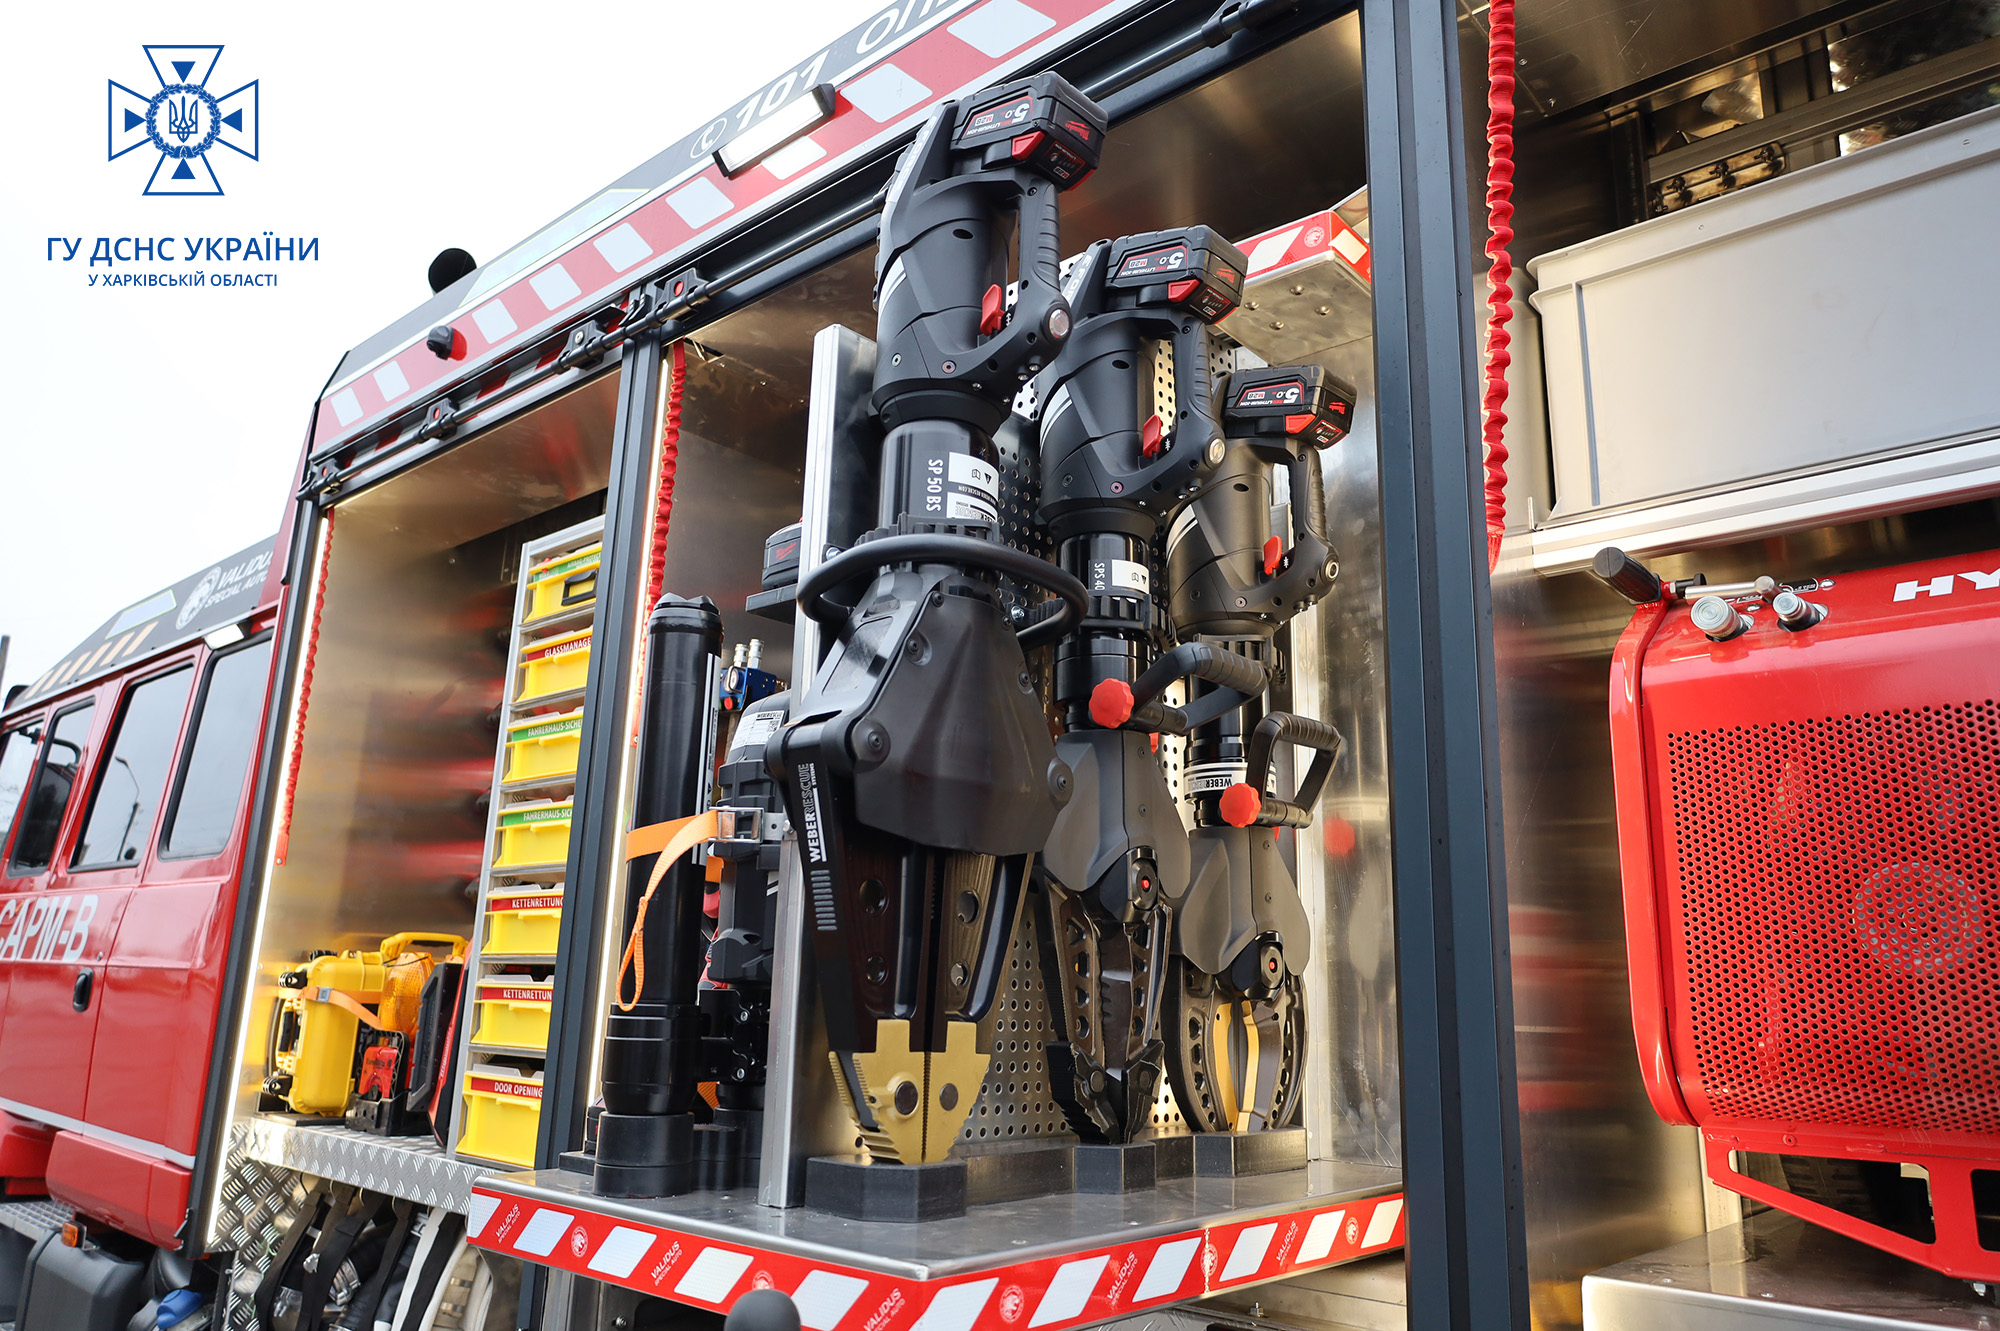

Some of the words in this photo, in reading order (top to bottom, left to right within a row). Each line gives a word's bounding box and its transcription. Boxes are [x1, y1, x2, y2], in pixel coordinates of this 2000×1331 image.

[975, 114, 994, 126] M28
[927, 458, 944, 475] SP
[926, 477, 943, 493] 50
[925, 495, 942, 512] BS
[217, 550, 273, 591] VALIDU
[1094, 562, 1106, 579] SPS
[1094, 580, 1106, 591] 40
[544, 637, 592, 658] GLASSMANAGE
[494, 1081, 512, 1094] DOOR
[513, 1084, 543, 1099] OPENING
[495, 1203, 519, 1237] VALIDUS
[1276, 1220, 1297, 1260] VALIDUS
[651, 1240, 680, 1279] VALIDUS
[1107, 1251, 1135, 1300] VALIDUS
